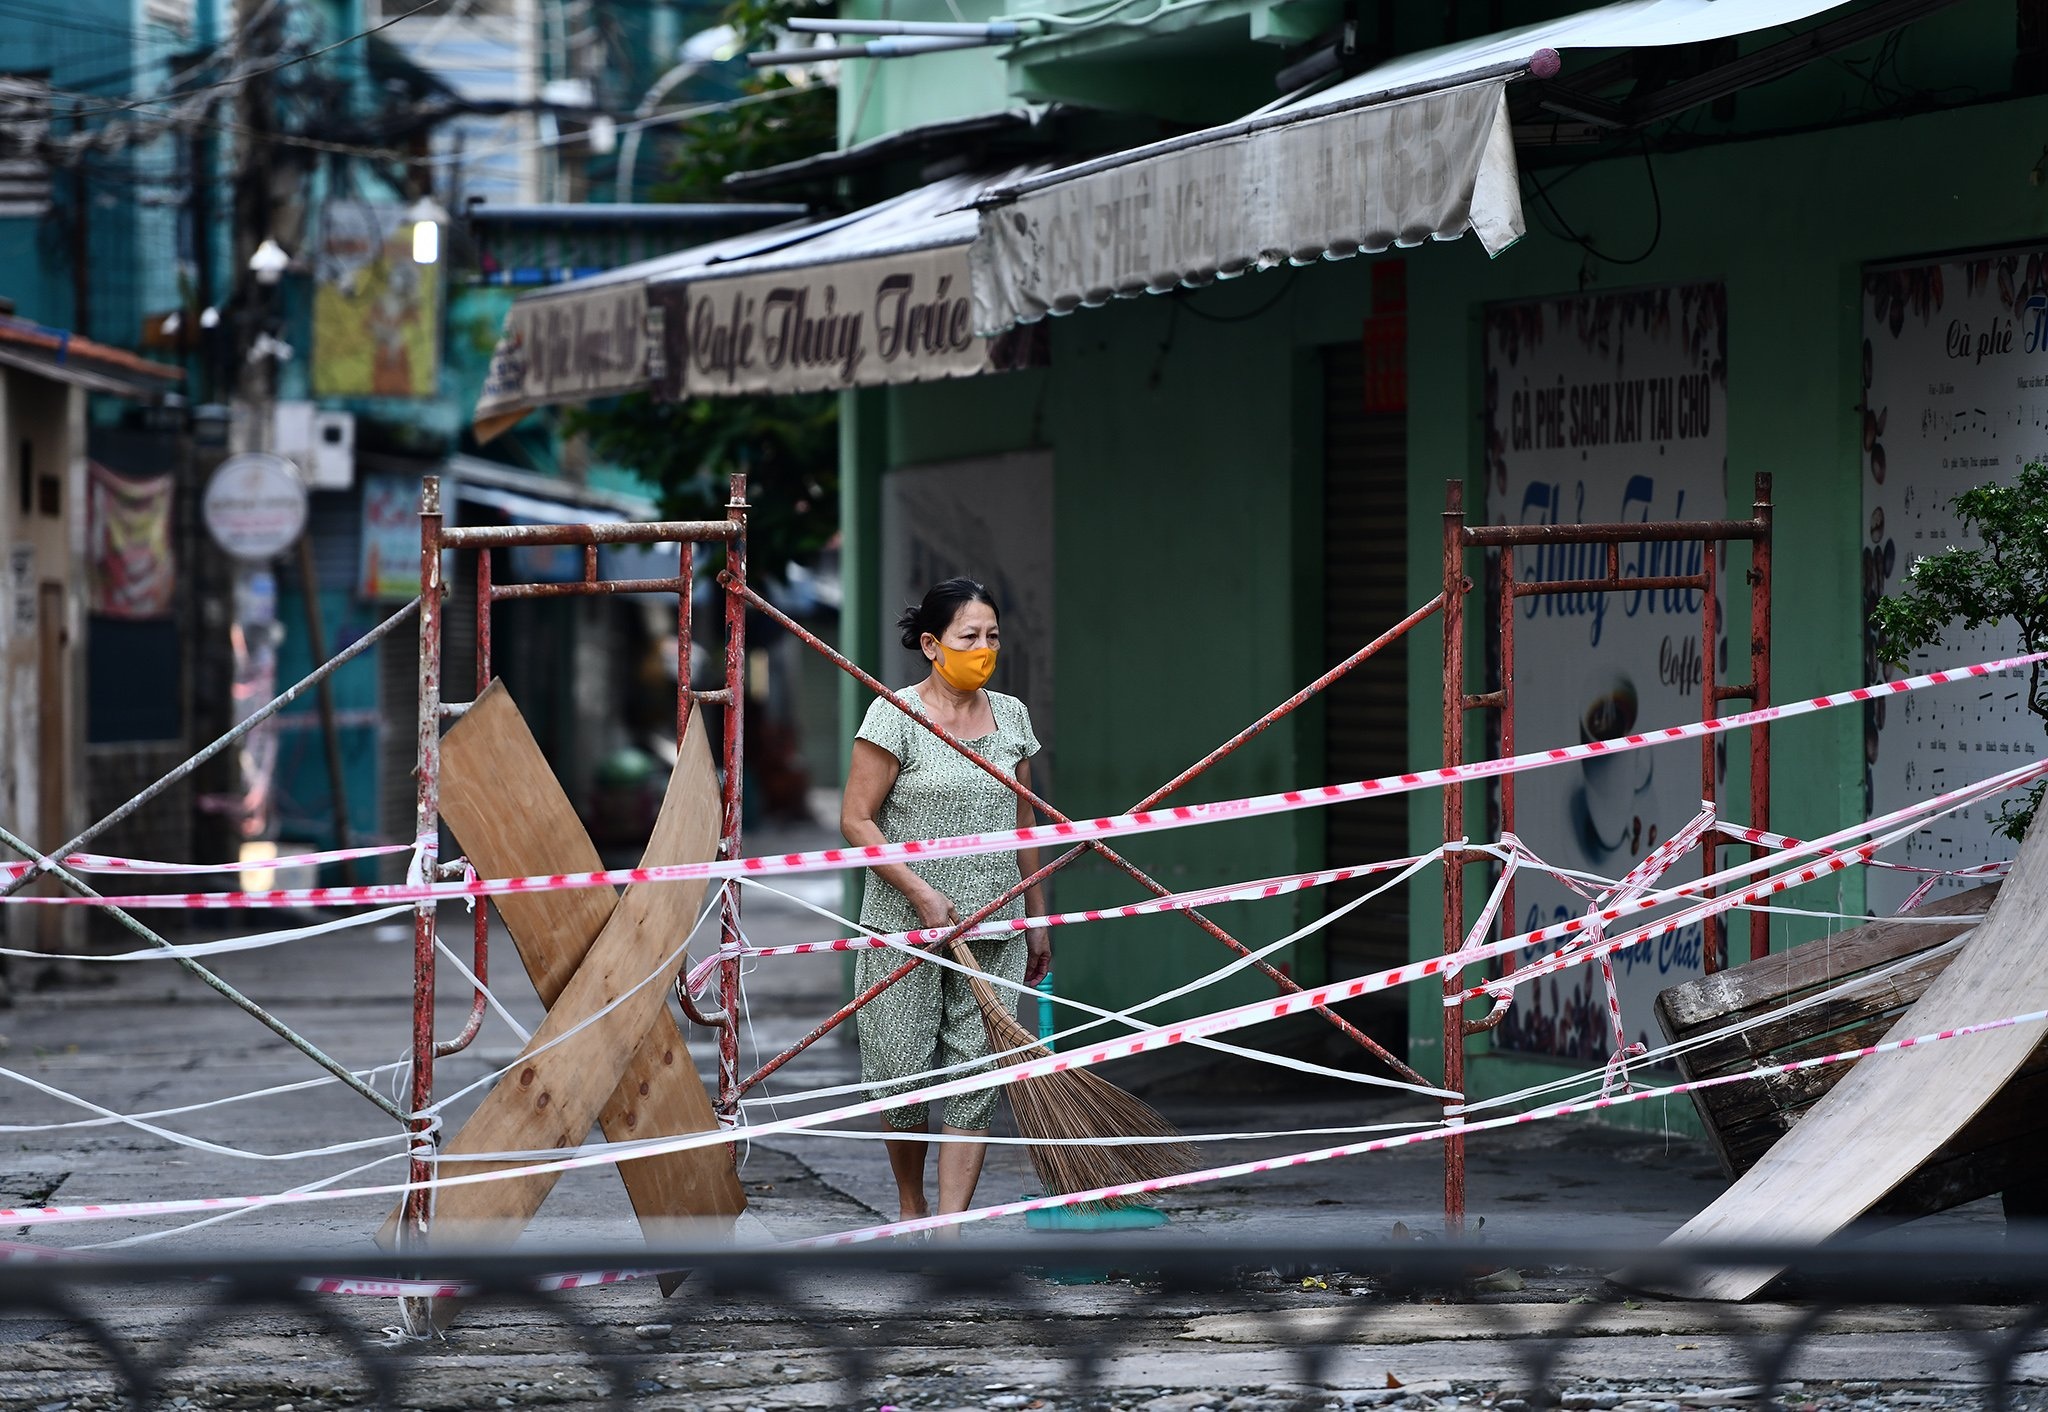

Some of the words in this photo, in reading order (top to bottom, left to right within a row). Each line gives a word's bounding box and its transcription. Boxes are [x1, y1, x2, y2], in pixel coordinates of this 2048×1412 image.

[694, 290, 755, 386] Café
[875, 273, 974, 362] Trúc
[1946, 319, 1971, 358] Cà
[1976, 316, 2014, 365] phê
[1512, 376, 1532, 451] CÀ
[1536, 373, 1565, 449] PHÊ
[1570, 383, 1610, 460] SẠCH
[1614, 380, 1645, 443] XAY
[1648, 377, 1673, 455] TẠI
[1678, 349, 1711, 439] CHỖ
[1659, 635, 1704, 696] Coffe
